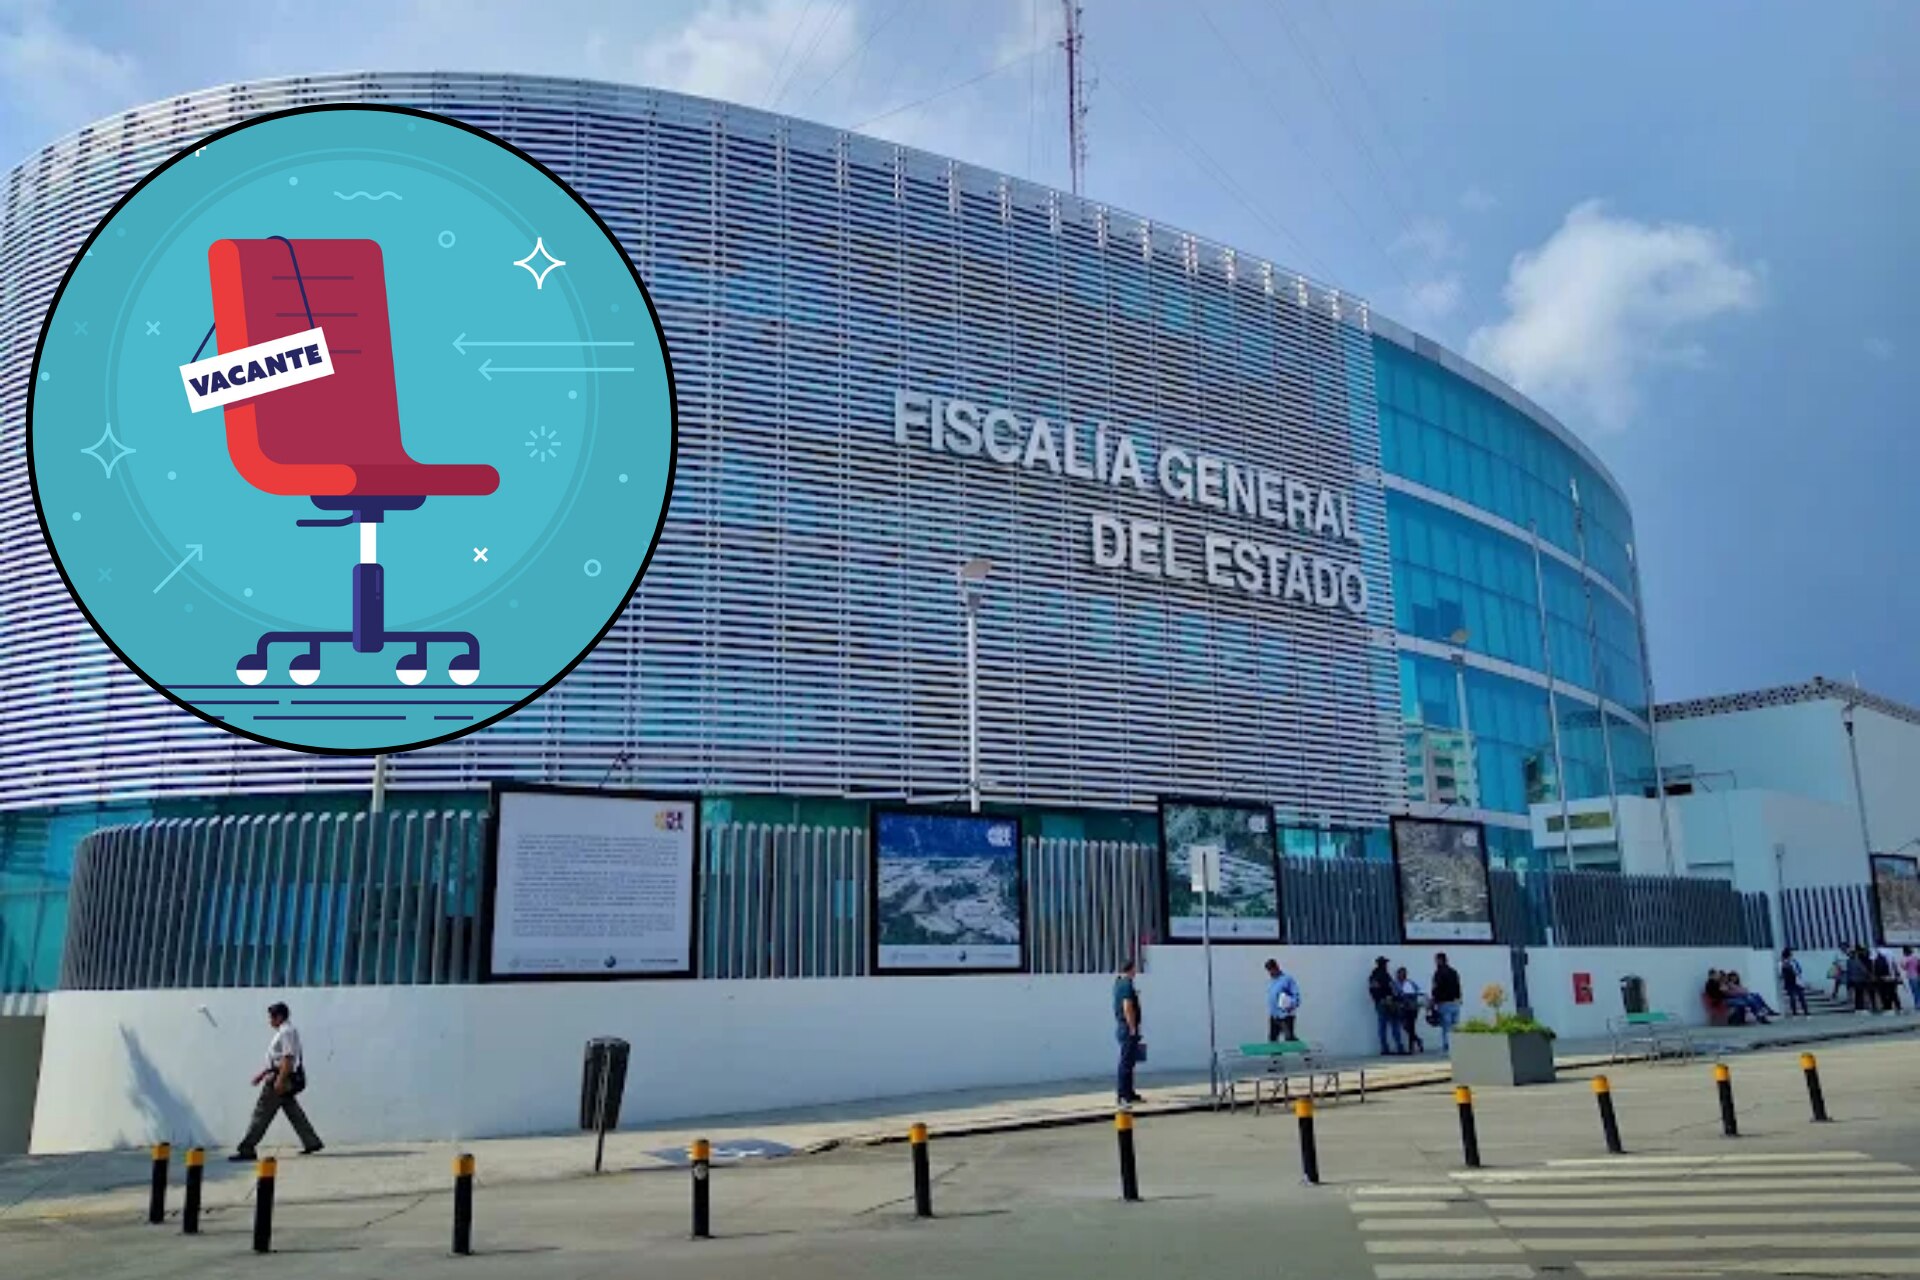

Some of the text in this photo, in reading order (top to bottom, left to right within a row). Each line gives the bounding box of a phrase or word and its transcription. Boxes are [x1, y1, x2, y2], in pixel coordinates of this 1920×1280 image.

[894, 389, 1364, 541] FISCALÍA GENERAL
[1091, 515, 1368, 614] DEL ESTADO
